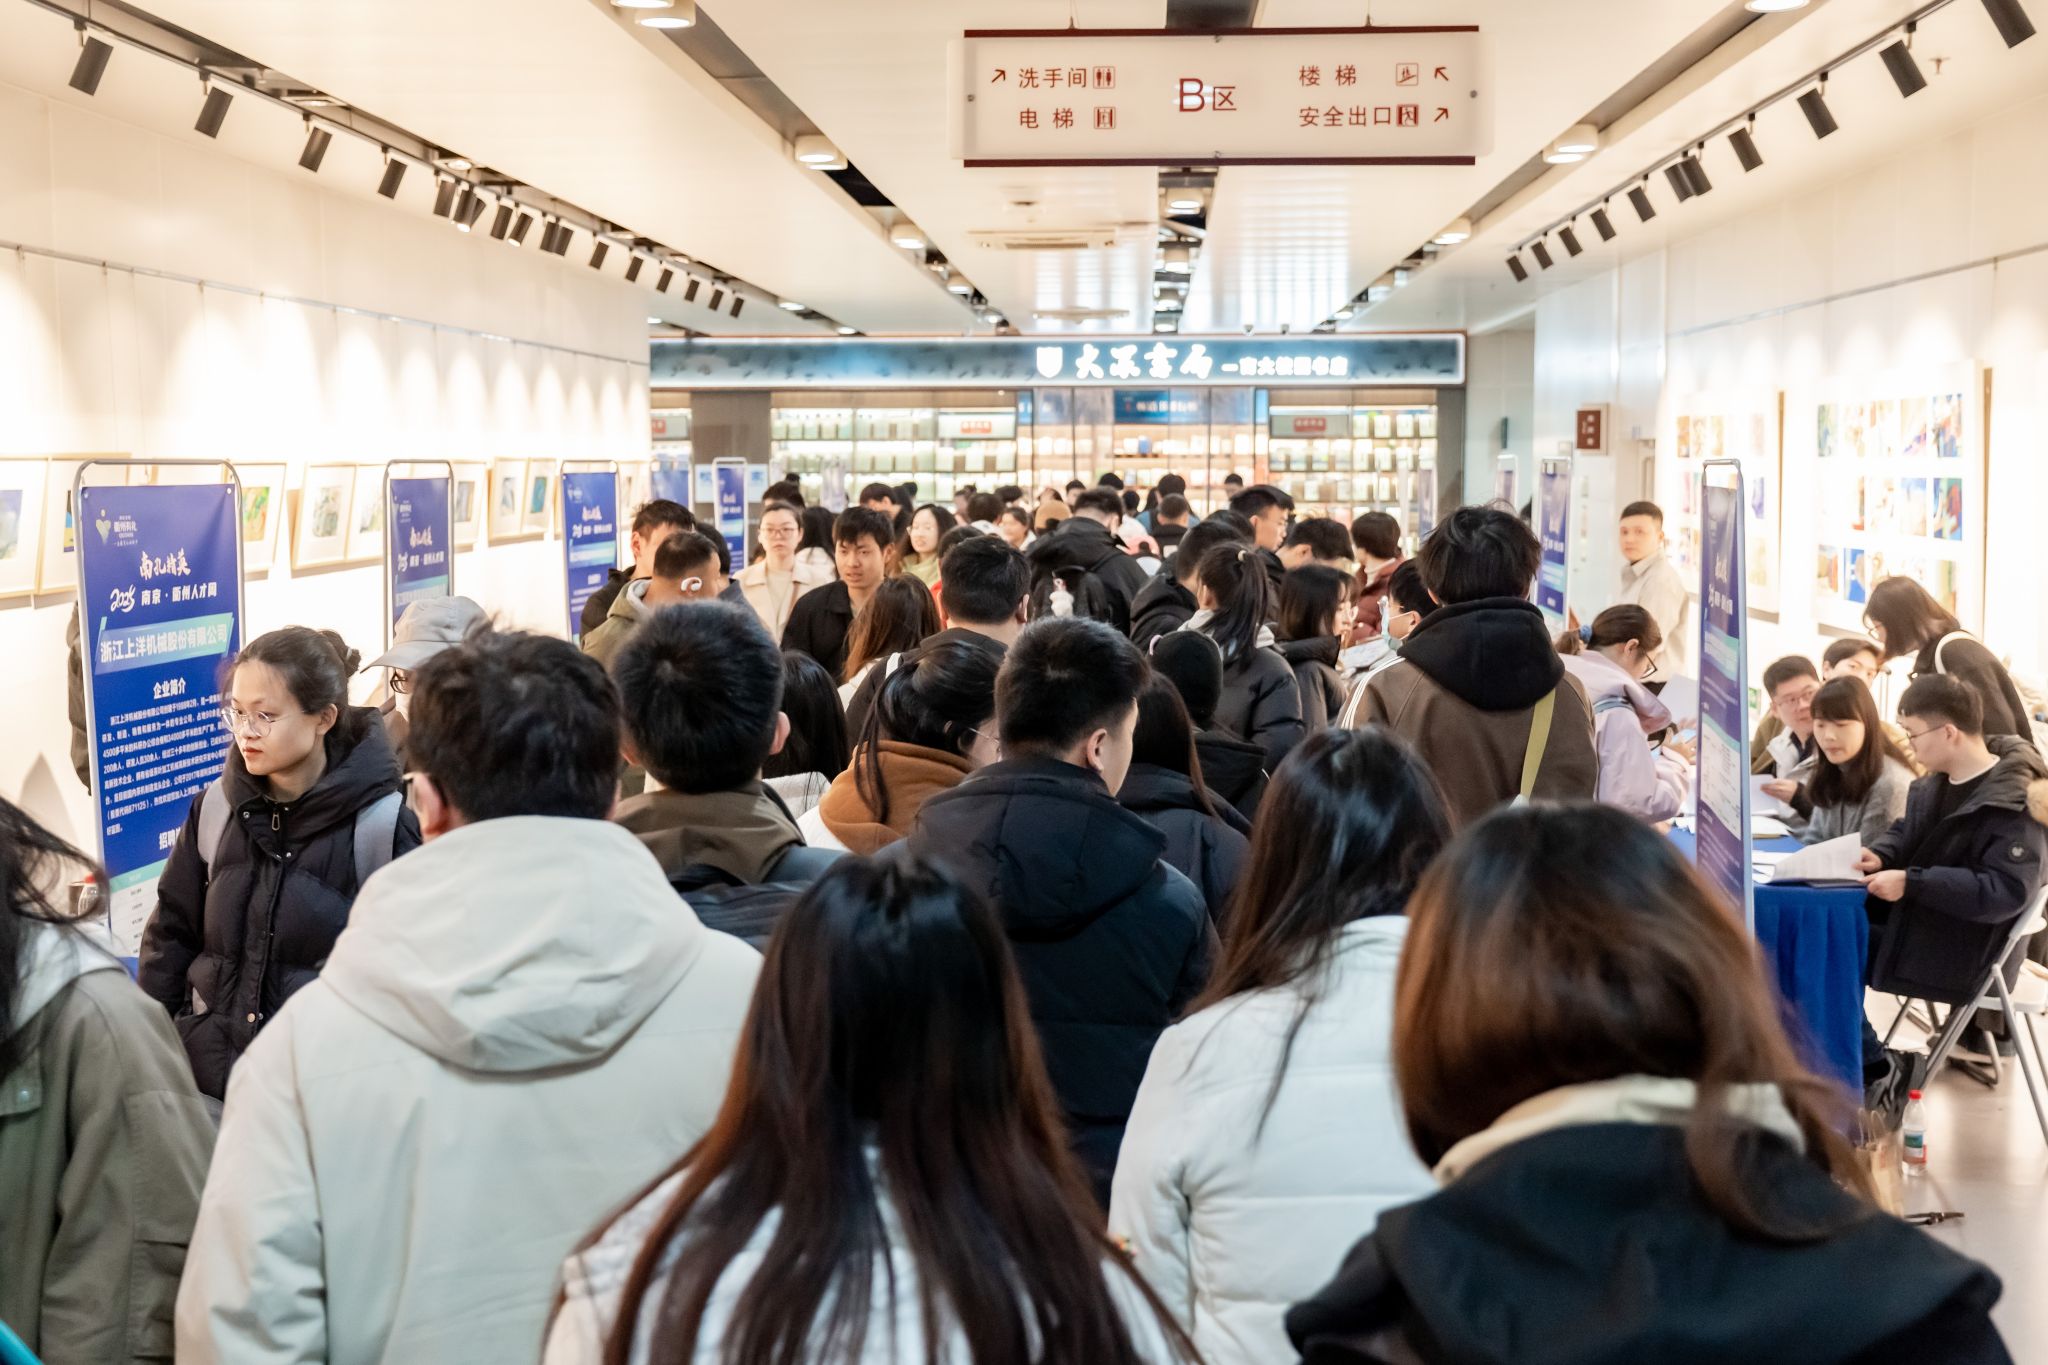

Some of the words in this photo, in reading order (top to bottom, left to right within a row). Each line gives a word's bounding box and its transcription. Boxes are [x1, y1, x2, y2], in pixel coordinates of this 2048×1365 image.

[1018, 67, 1087, 89] 洗手间
[1299, 65, 1356, 86] 楼梯
[1178, 77, 1237, 112] B区
[1019, 108, 1074, 129] 电梯
[1299, 106, 1392, 128] 安全出口
[101, 624, 227, 663] 浙江上洋机械股份有限公司
[153, 677, 186, 700] 企业简介
